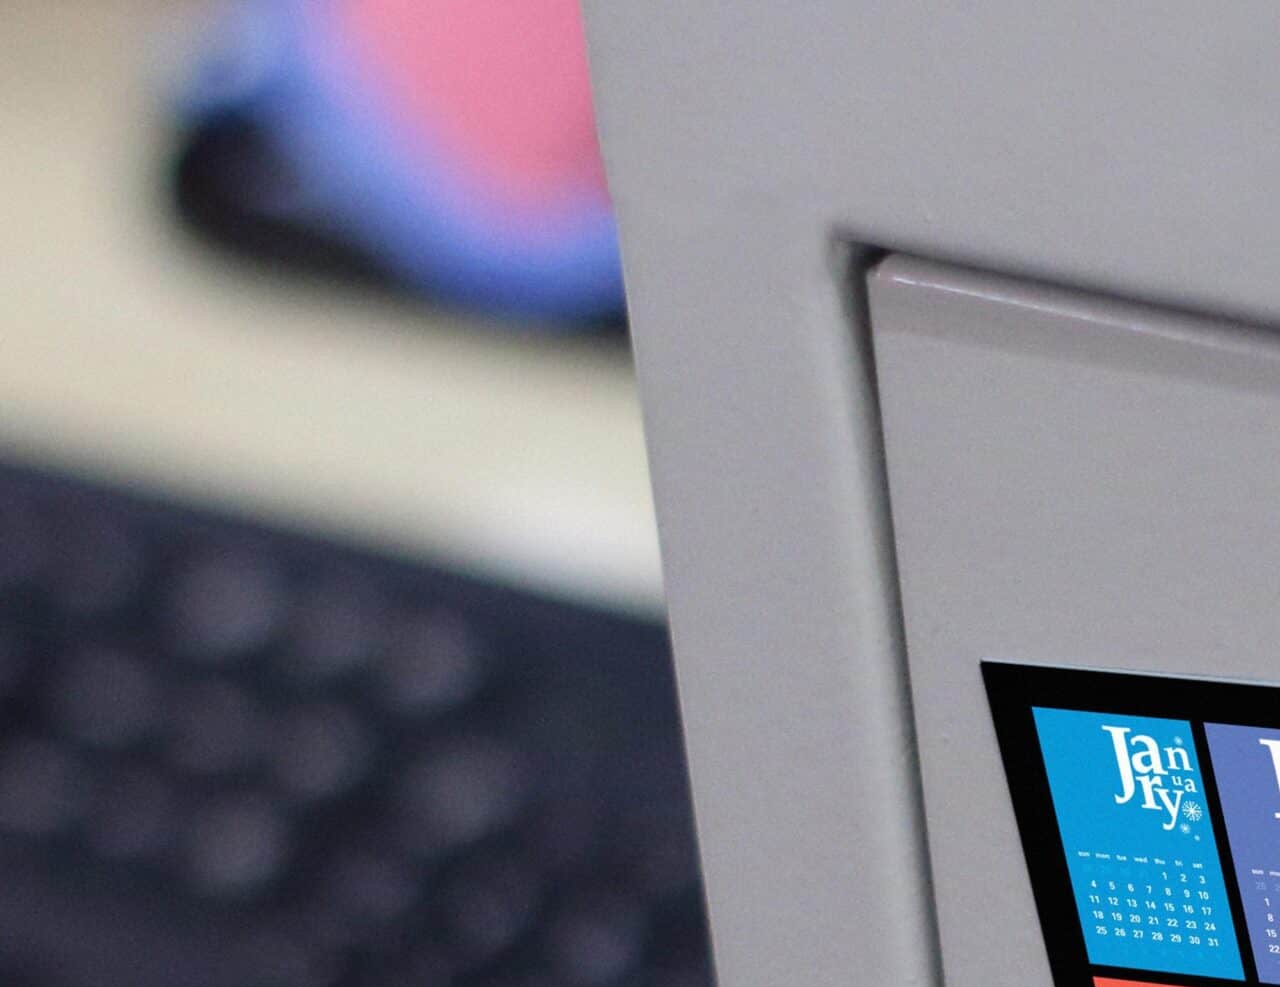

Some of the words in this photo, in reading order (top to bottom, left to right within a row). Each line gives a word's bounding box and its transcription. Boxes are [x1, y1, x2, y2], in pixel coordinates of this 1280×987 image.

[1161, 871, 1168, 881] 1
[1179, 873, 1188, 883] 2
[1198, 874, 1207, 885] 3
[1090, 879, 1098, 889] 4
[1108, 880, 1116, 891] 5
[1127, 883, 1135, 893] 6
[1145, 884, 1153, 895] 7
[1164, 887, 1172, 897] 8
[1183, 888, 1191, 899] 9
[1197, 890, 1210, 901] 10
[1088, 894, 1101, 904] 11
[1107, 896, 1119, 907] 12
[1126, 898, 1138, 909] 13
[1145, 900, 1157, 910] 14
[1163, 902, 1176, 912] 15
[1182, 904, 1195, 915] 16
[1200, 906, 1212, 916] 17
[1263, 897, 1271, 907] 1
[1266, 912, 1275, 923] 8
